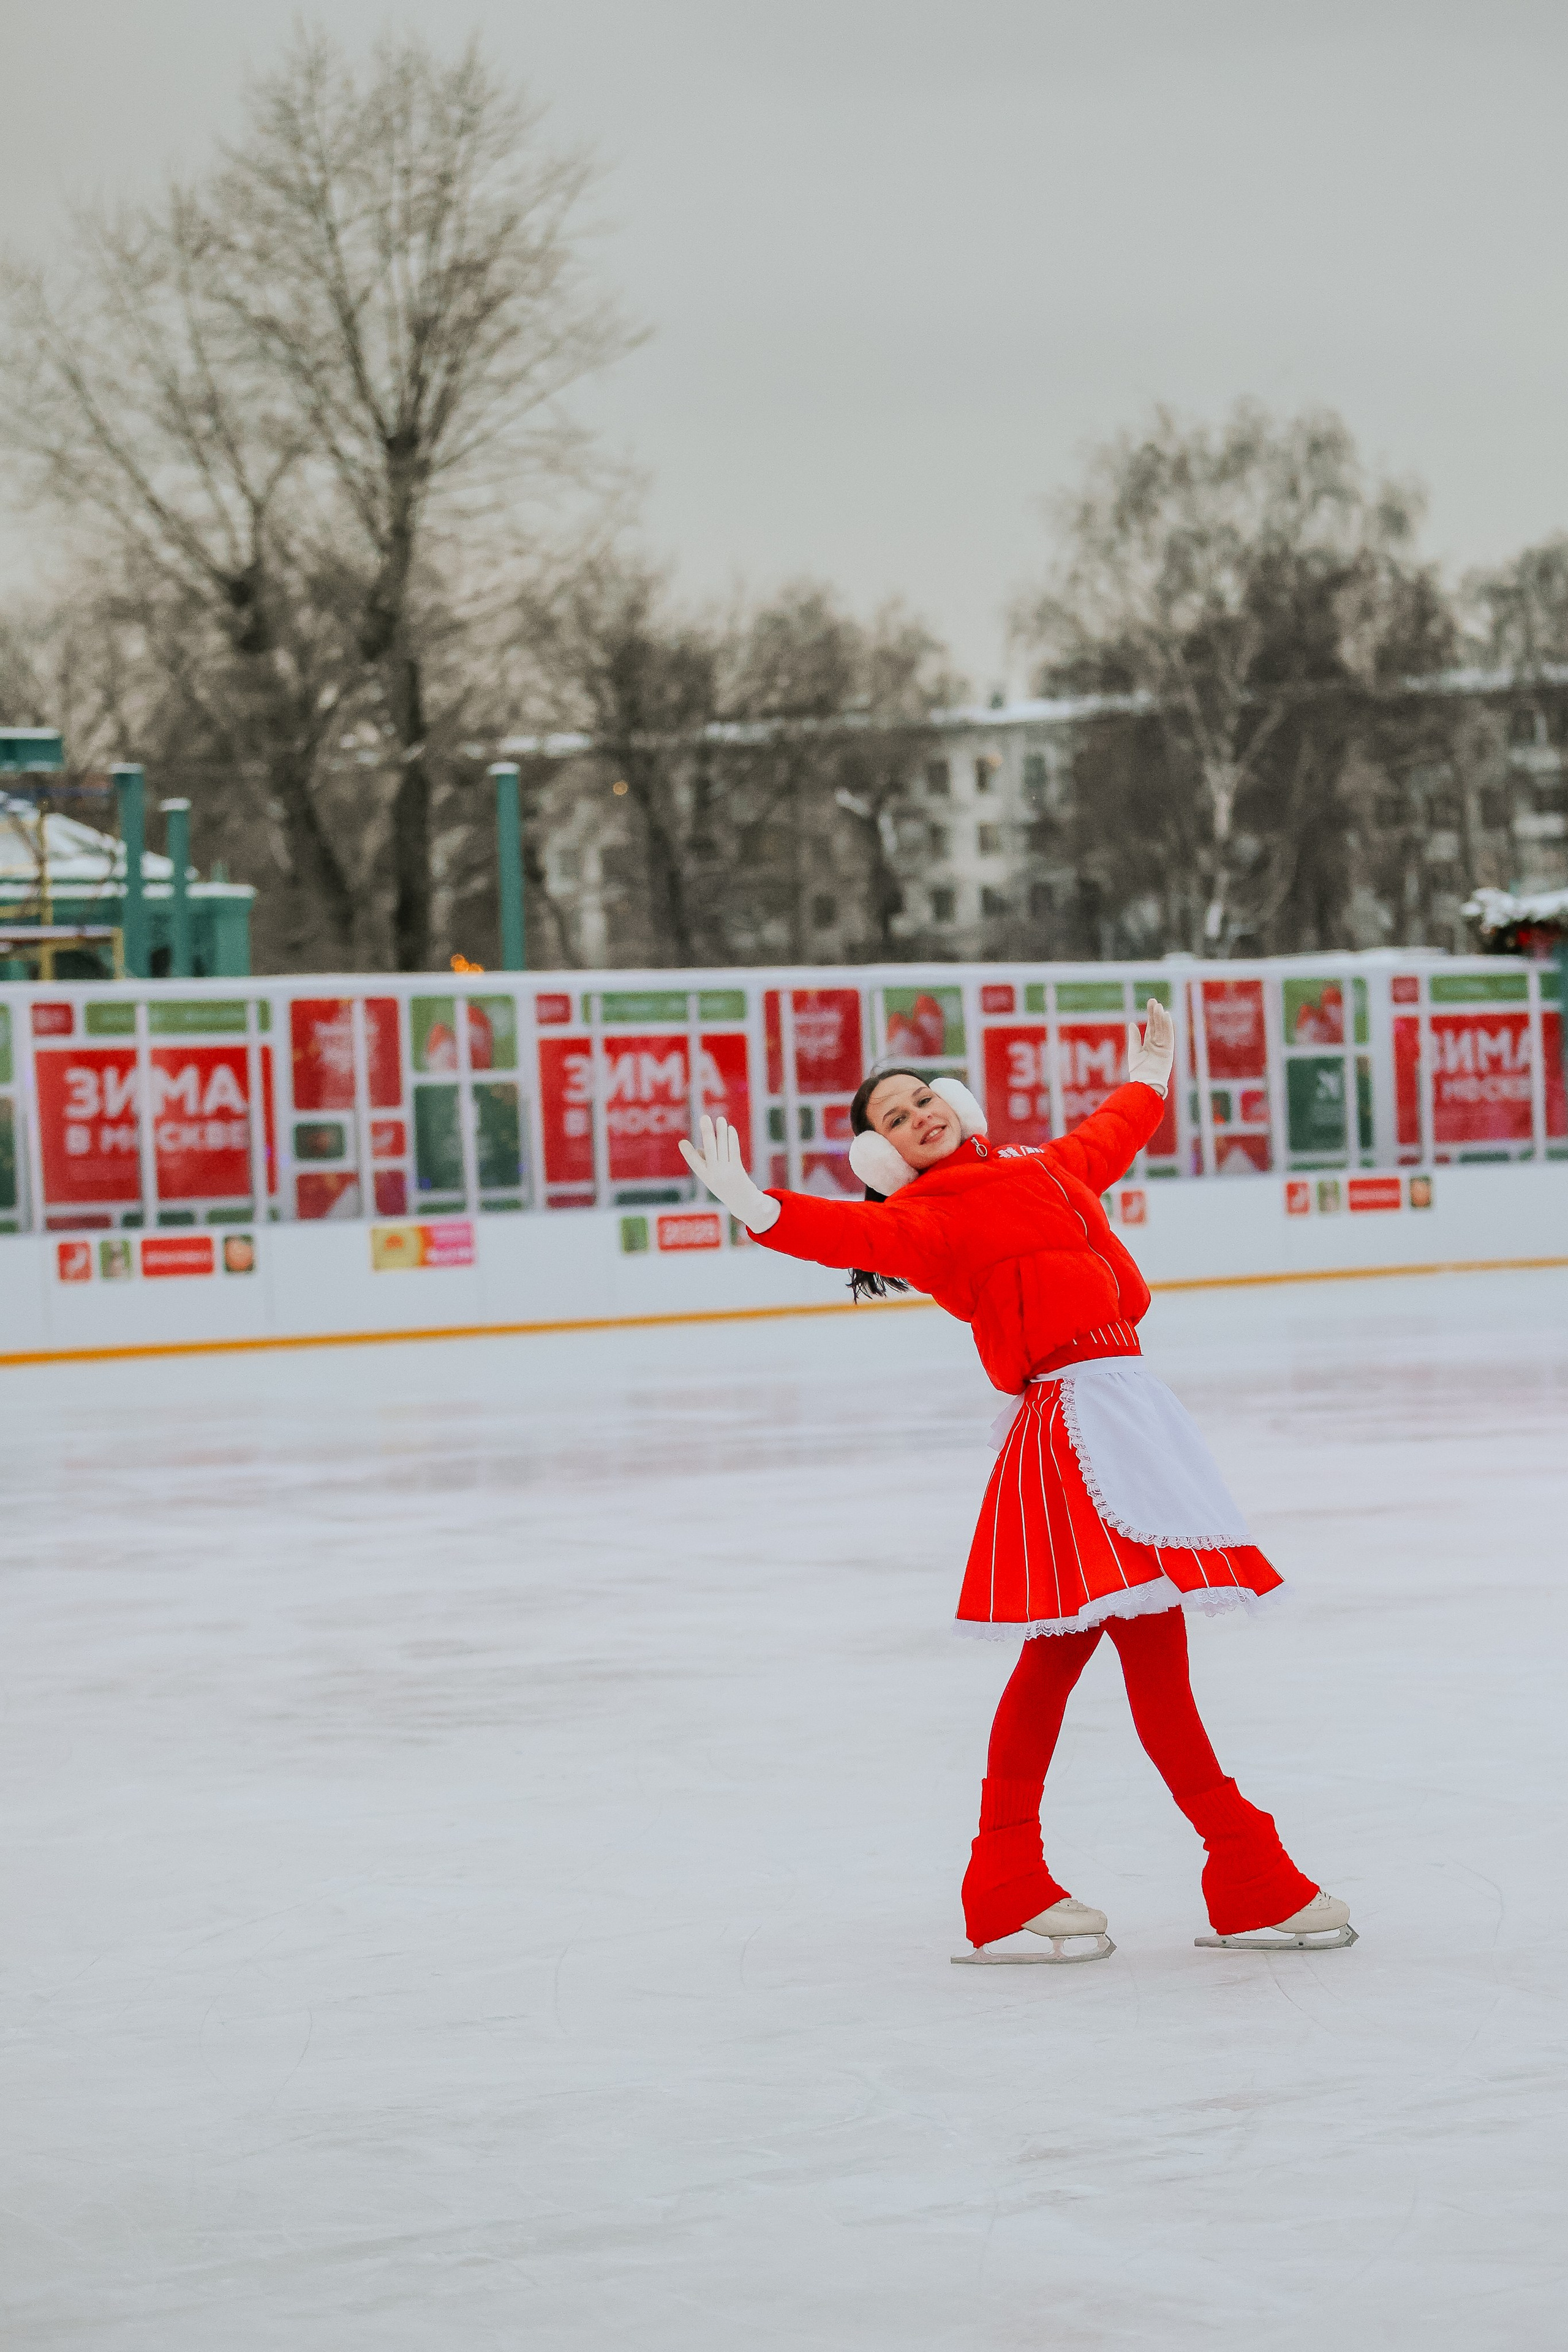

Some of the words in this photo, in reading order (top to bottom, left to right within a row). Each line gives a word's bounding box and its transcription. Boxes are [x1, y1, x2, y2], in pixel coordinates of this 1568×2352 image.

[1006, 1039, 1129, 1088] ЗИМ
[64, 1065, 247, 1118] ЗИМА
[100, 1120, 248, 1154] МСКВЕ
